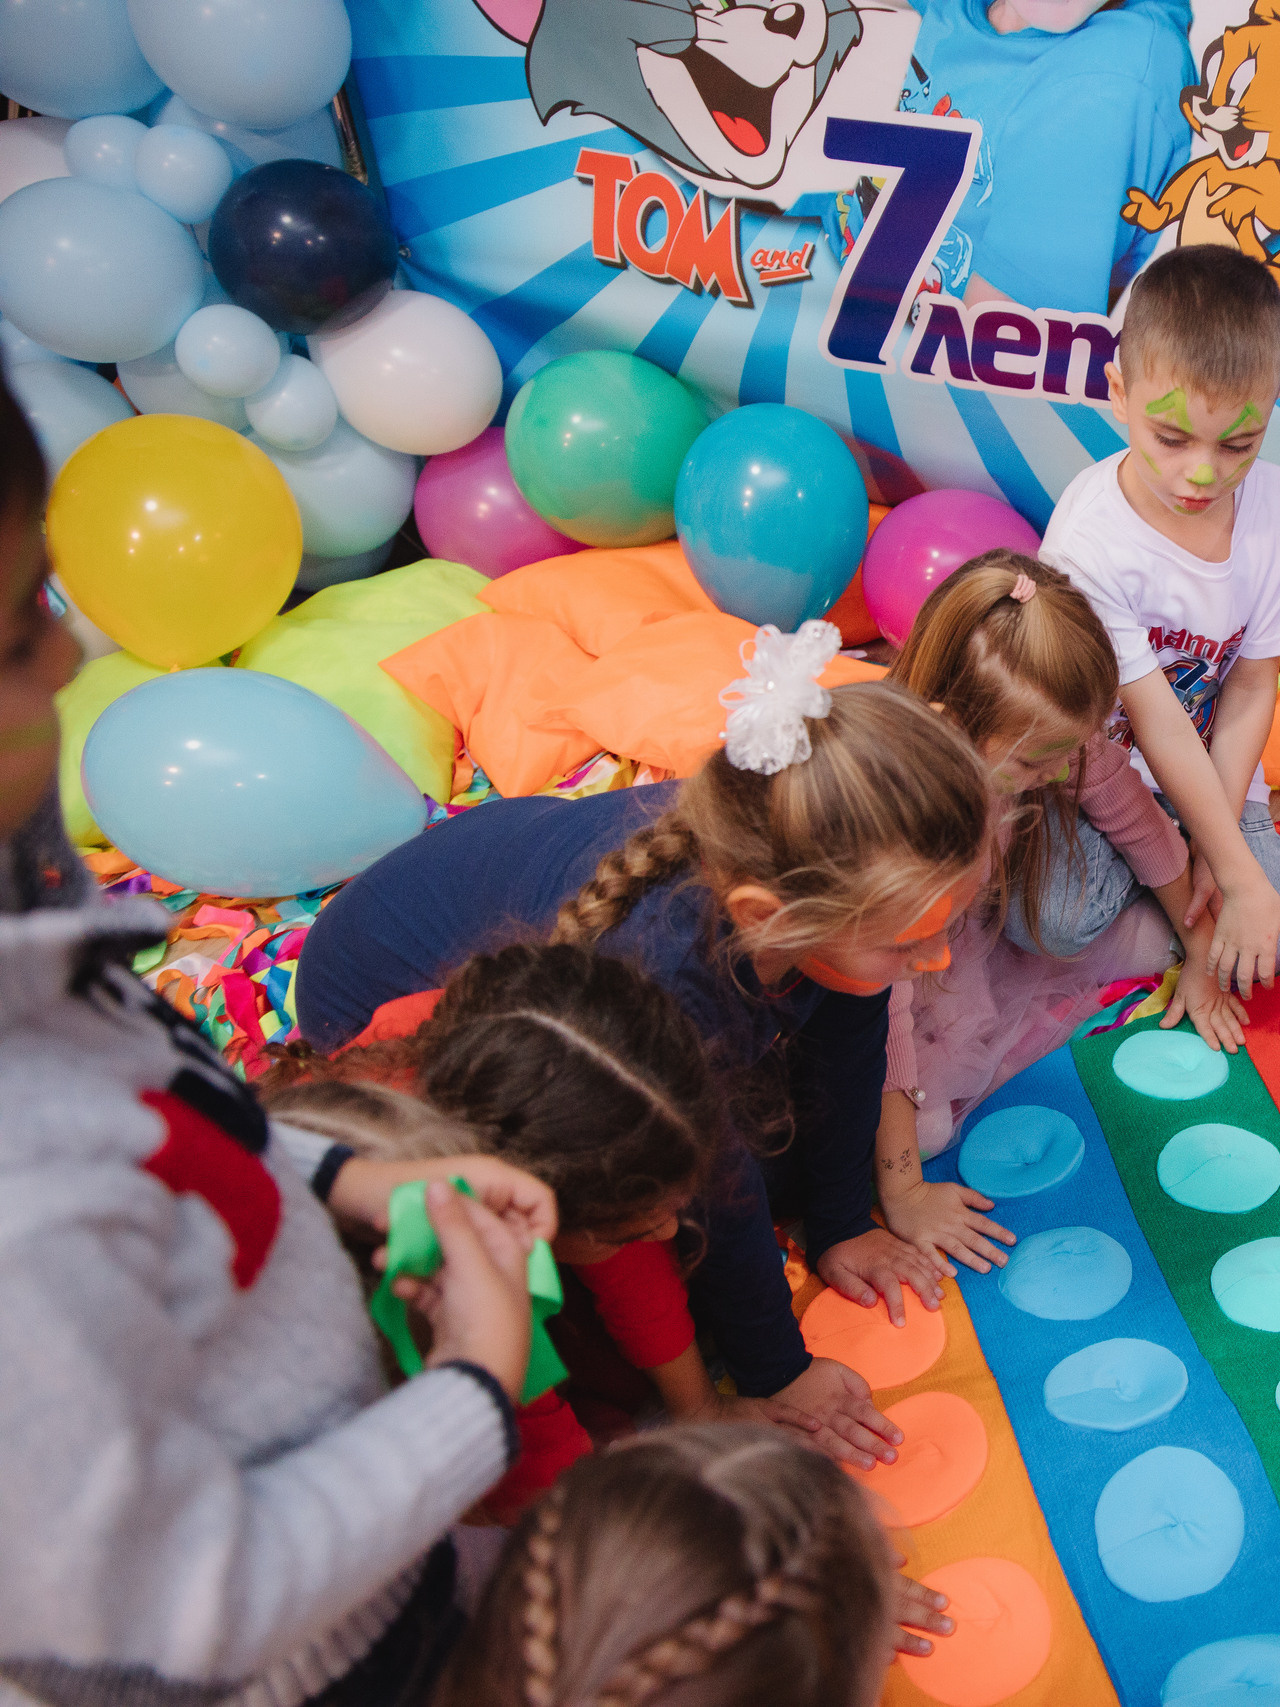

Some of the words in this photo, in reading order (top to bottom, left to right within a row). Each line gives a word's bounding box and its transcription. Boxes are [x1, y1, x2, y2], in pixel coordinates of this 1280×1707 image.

[573, 147, 752, 307] TOM
[750, 241, 816, 286] and
[823, 116, 973, 366] 7
